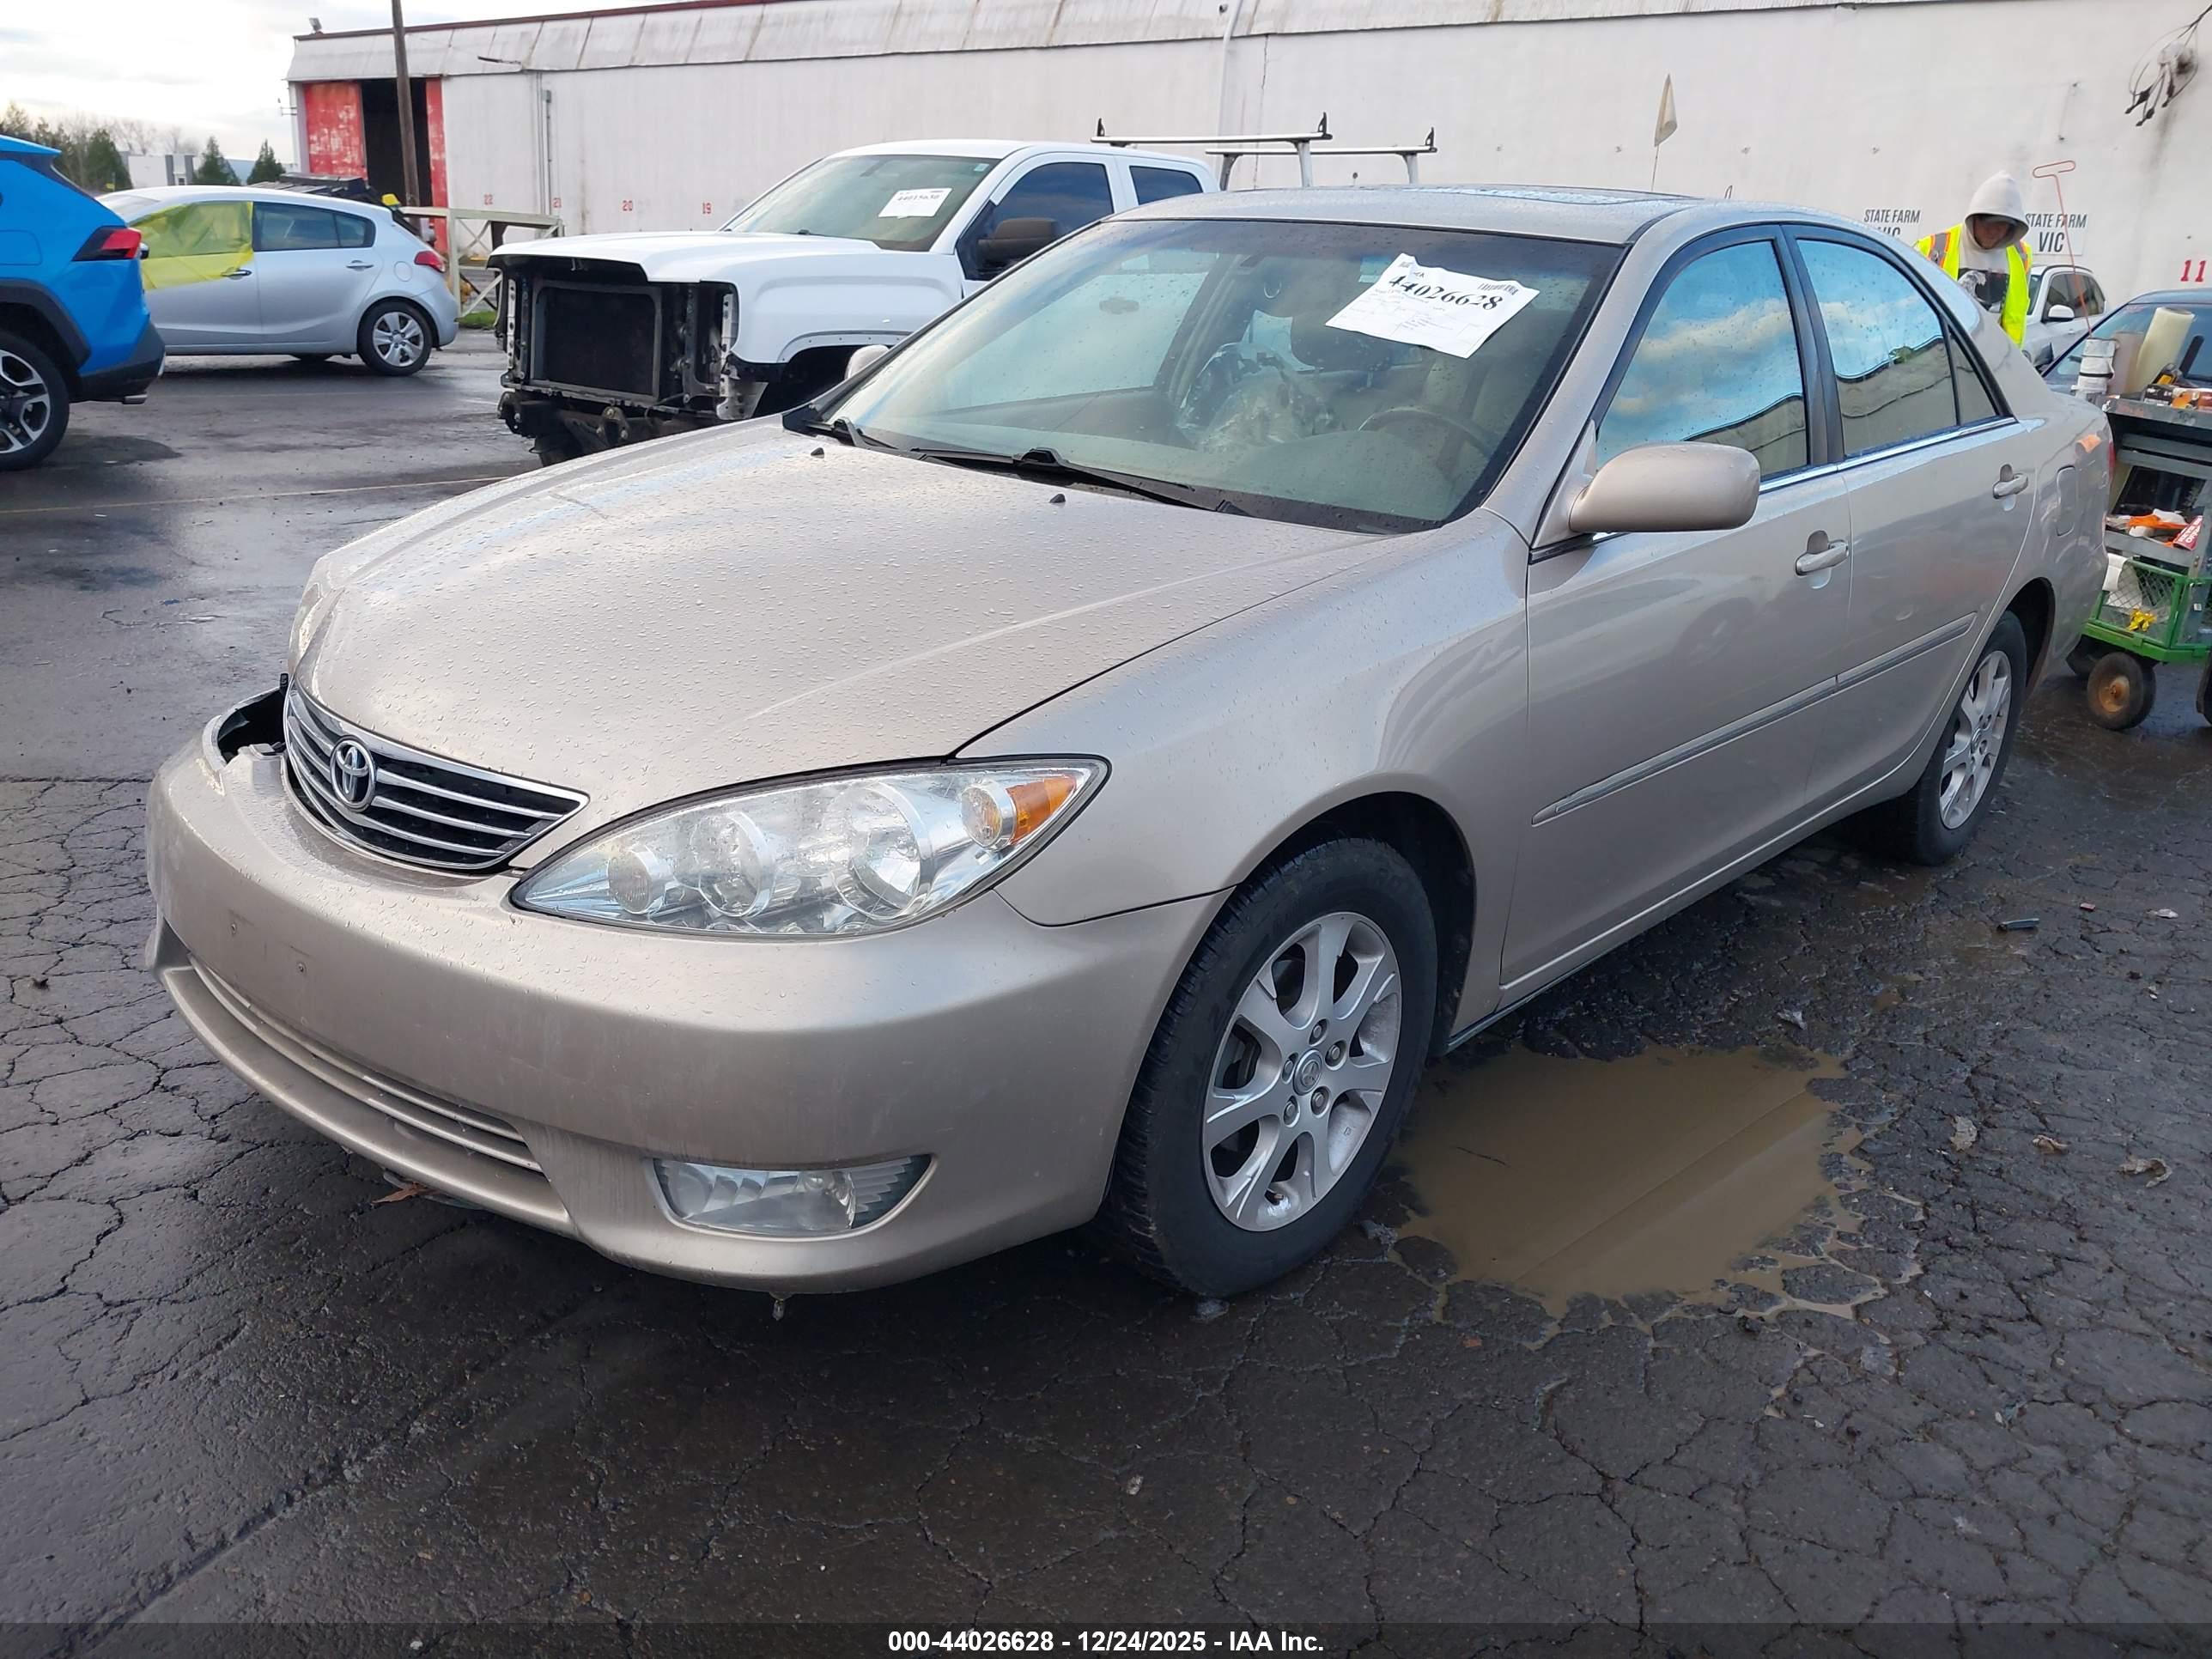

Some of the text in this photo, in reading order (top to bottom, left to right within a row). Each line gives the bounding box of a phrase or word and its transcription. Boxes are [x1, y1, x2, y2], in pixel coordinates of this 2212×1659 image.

[622, 199, 634, 211] 20
[702, 202, 712, 214] 19
[1863, 209, 1921, 223] STATE FARM
[2025, 213, 2087, 228] STATE FARM
[2039, 231, 2065, 252] VIC
[2180, 259, 2206, 283] 11
[1389, 275, 1504, 310] 44026628
